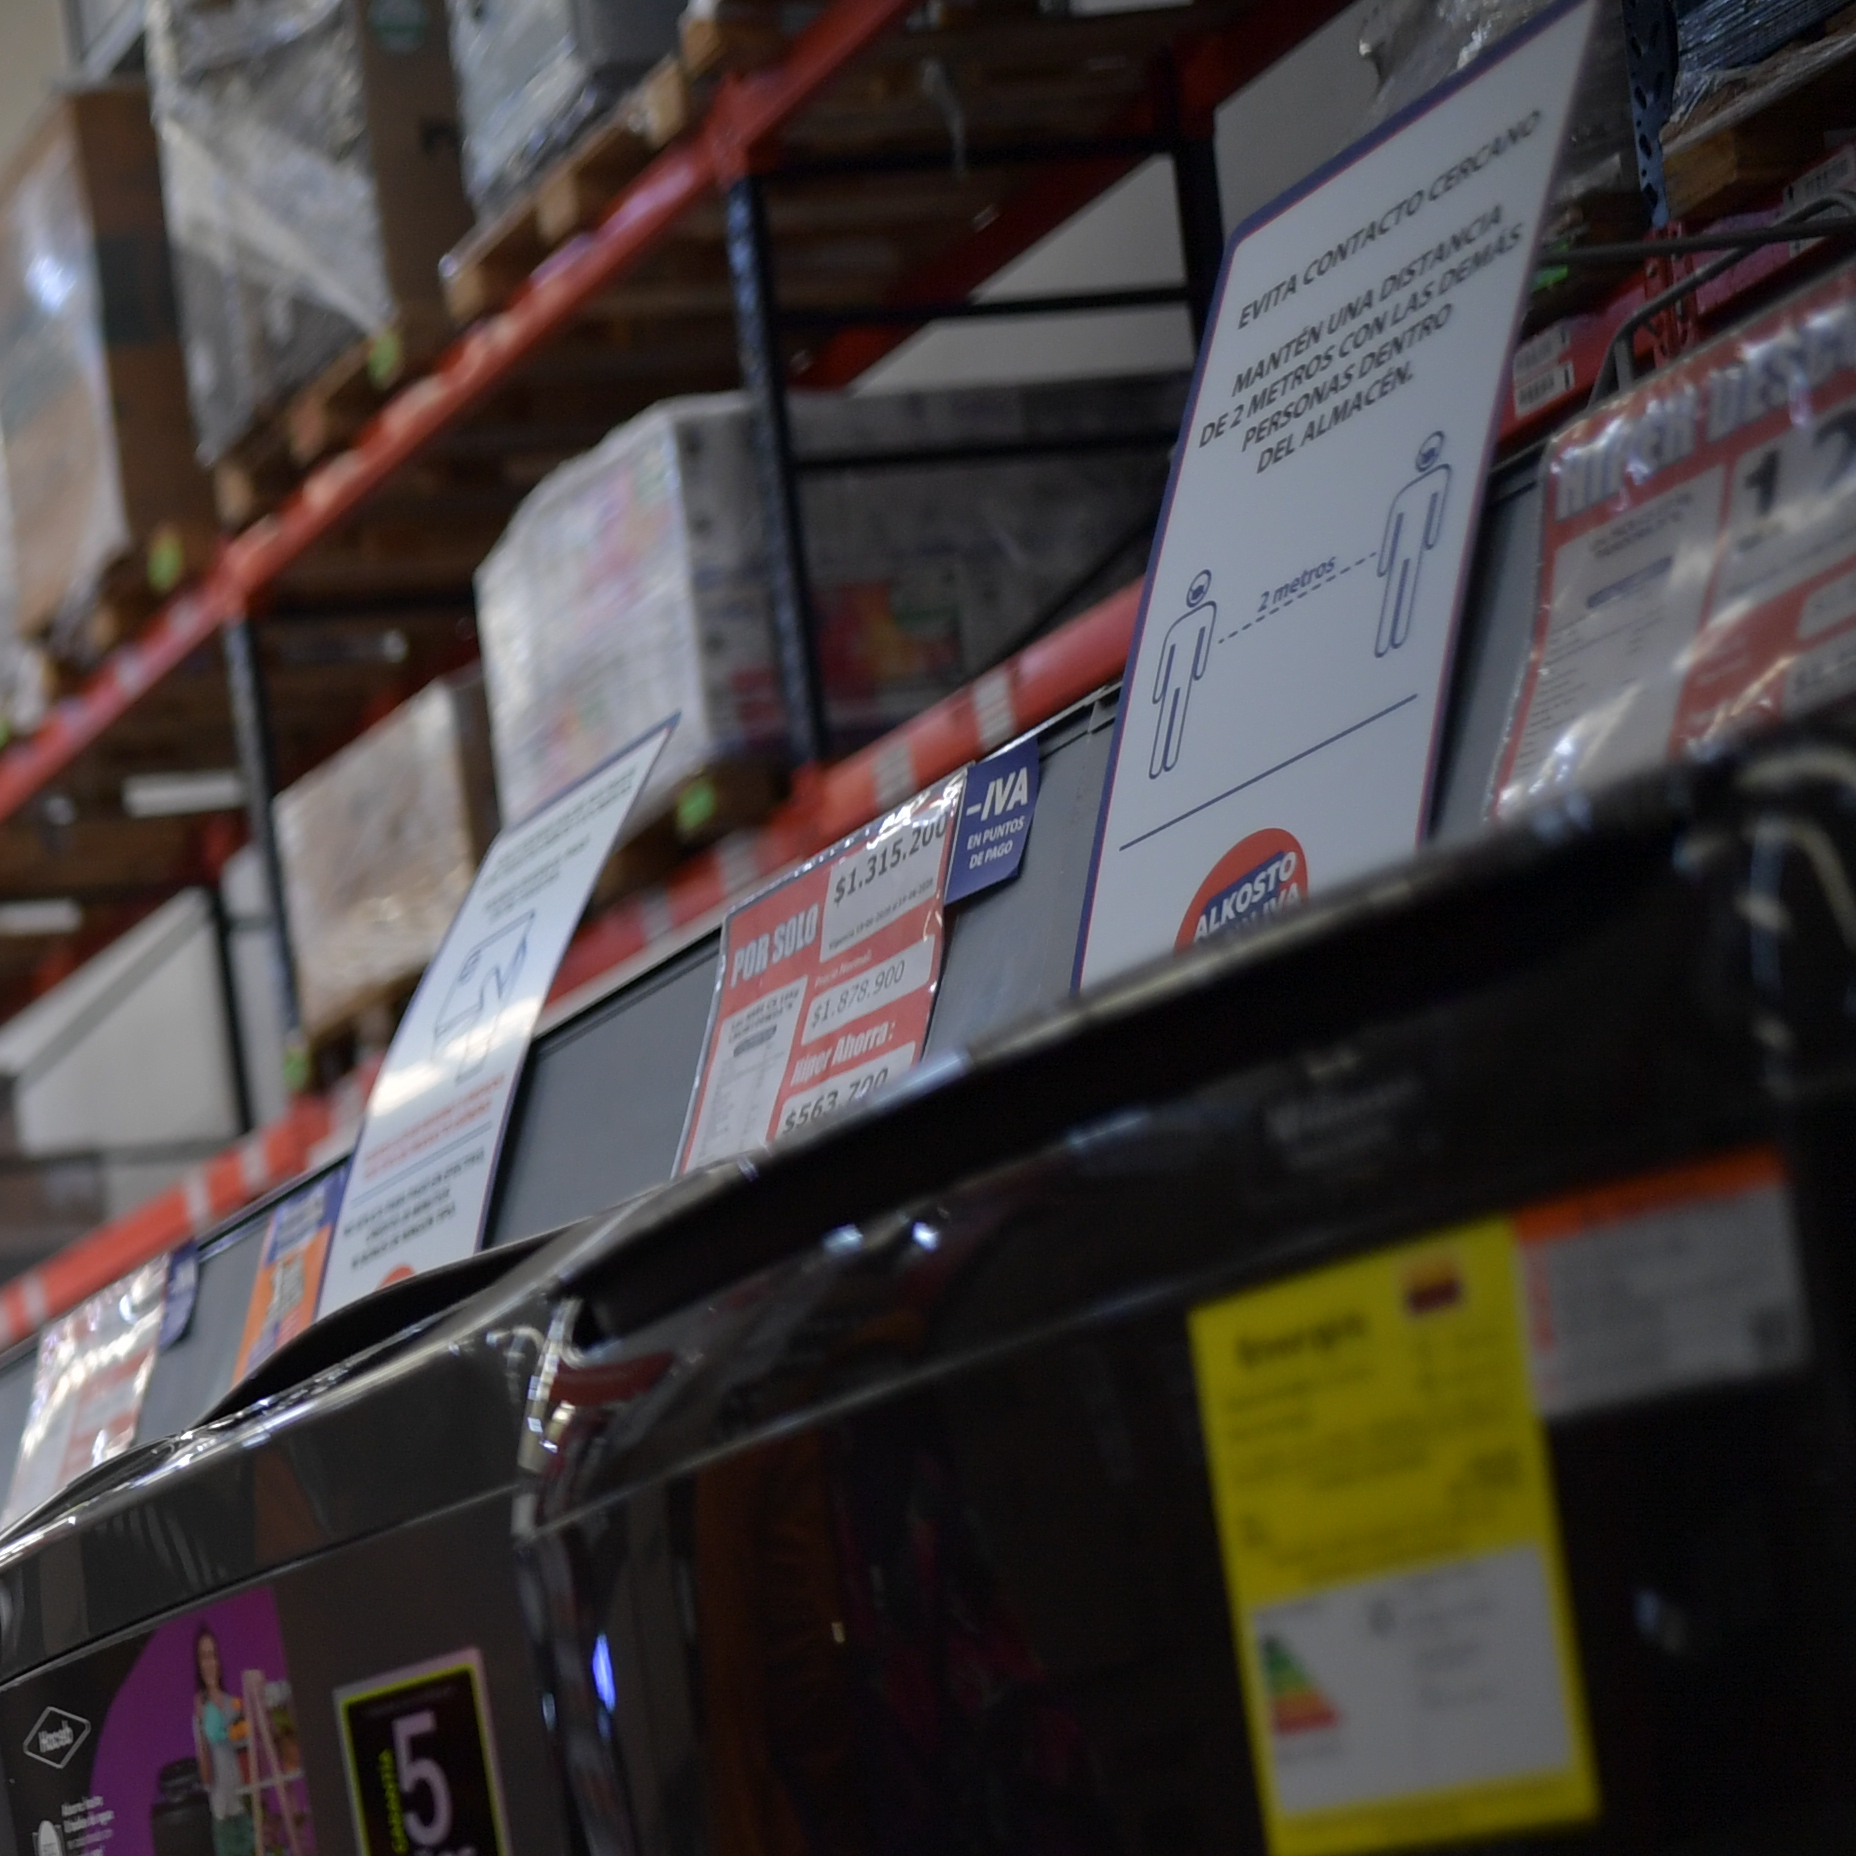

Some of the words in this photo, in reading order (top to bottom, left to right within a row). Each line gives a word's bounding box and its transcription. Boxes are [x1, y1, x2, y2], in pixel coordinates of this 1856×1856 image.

[1238, 275, 1298, 330] EVITA
[1303, 189, 1425, 286] CONTACTO
[1428, 109, 1541, 201] CERCANO
[1200, 421, 1228, 449] DE
[1230, 404, 1244, 429] 2
[1247, 345, 1333, 415] METROS
[1338, 311, 1384, 360] CON
[1390, 281, 1433, 324] LAS
[1437, 222, 1524, 296] DEMÁS
[1232, 324, 1320, 398] MANTÉN
[1327, 288, 1374, 335] UNA
[1378, 204, 1502, 302] DISTANCIA
[1242, 366, 1353, 452] PERSONAS
[1357, 303, 1454, 381] DENTRO
[1257, 438, 1296, 474] DEL
[1300, 360, 1415, 448] ALMACÉN.
[1258, 590, 1270, 612] 2
[1273, 556, 1336, 604] metros
[834, 809, 948, 904] $1.315.200
[967, 834, 980, 851] EN
[982, 815, 1025, 847] PUNTOS
[969, 853, 982, 870] DE
[983, 840, 1013, 862] PAGO
[1193, 851, 1297, 944] ALKOSTO
[731, 932, 770, 989] POR
[772, 902, 819, 966] SOLO
[811, 960, 905, 1029] $1.878.900
[392, 1708, 454, 1846] 5
